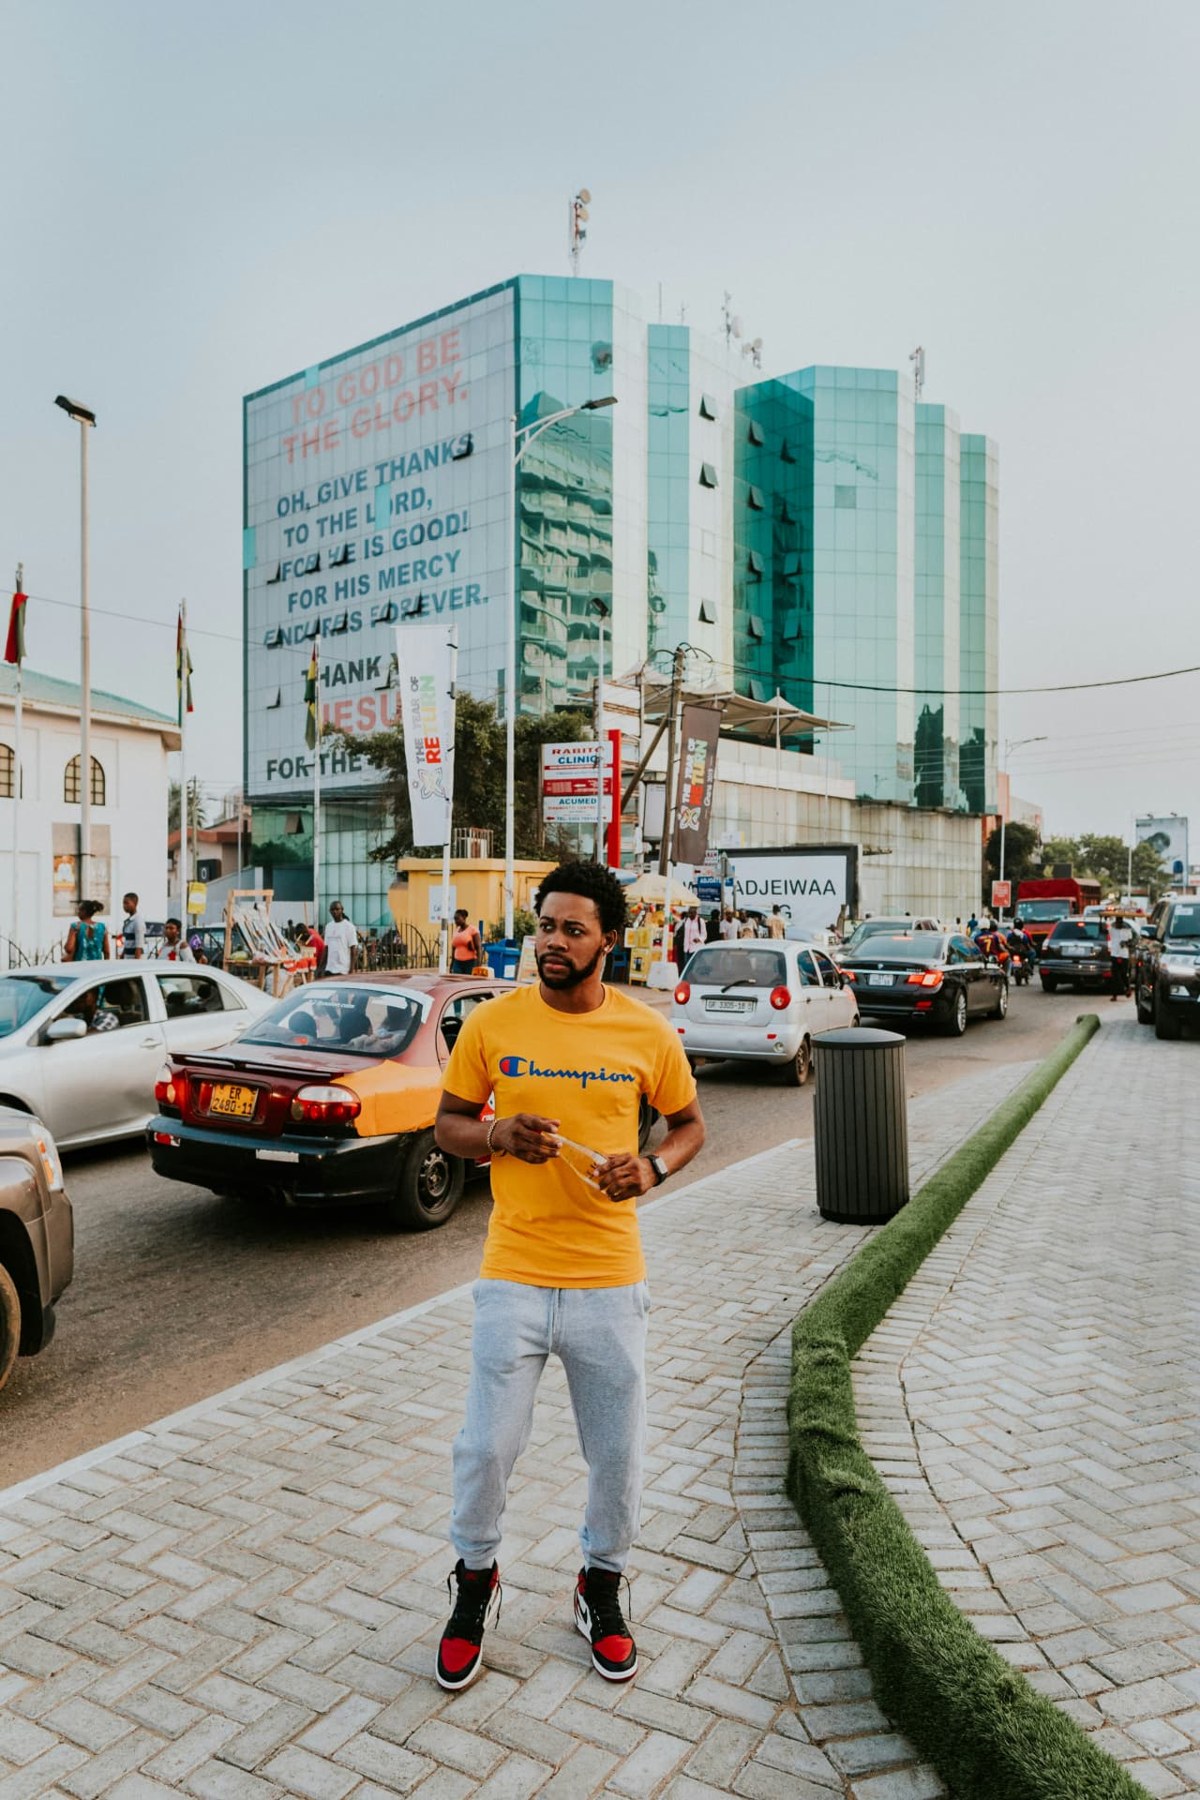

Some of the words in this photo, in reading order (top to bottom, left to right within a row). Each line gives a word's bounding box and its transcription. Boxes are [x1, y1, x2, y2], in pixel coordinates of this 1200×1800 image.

[290, 386, 326, 424] TO
[335, 354, 404, 406] GOD
[416, 329, 461, 375] BE
[283, 419, 340, 465] THE
[350, 370, 468, 439] GLORY.
[277, 490, 311, 518] OH,
[317, 470, 368, 504] GIVE
[374, 434, 474, 487] THANKS
[284, 523, 309, 548] TO
[316, 508, 358, 538] THE
[365, 486, 433, 522] LRD,
[364, 535, 384, 559] IS
[391, 510, 470, 551] GOOD!
[288, 585, 328, 613] FOR
[334, 574, 371, 601] HIS
[378, 549, 461, 591] MERCY
[264, 611, 362, 649] ENDURES
[370, 583, 489, 628] FOREVER.
[410, 676, 419, 692] OF
[267, 757, 309, 781] FOR
[320, 751, 362, 776] THE
[415, 737, 426, 765] THE
[559, 797, 597, 806] ACUMED
[732, 879, 836, 896] ADJEIWAA
[499, 1055, 636, 1089] Champion
[229, 1087, 242, 1100] ER
